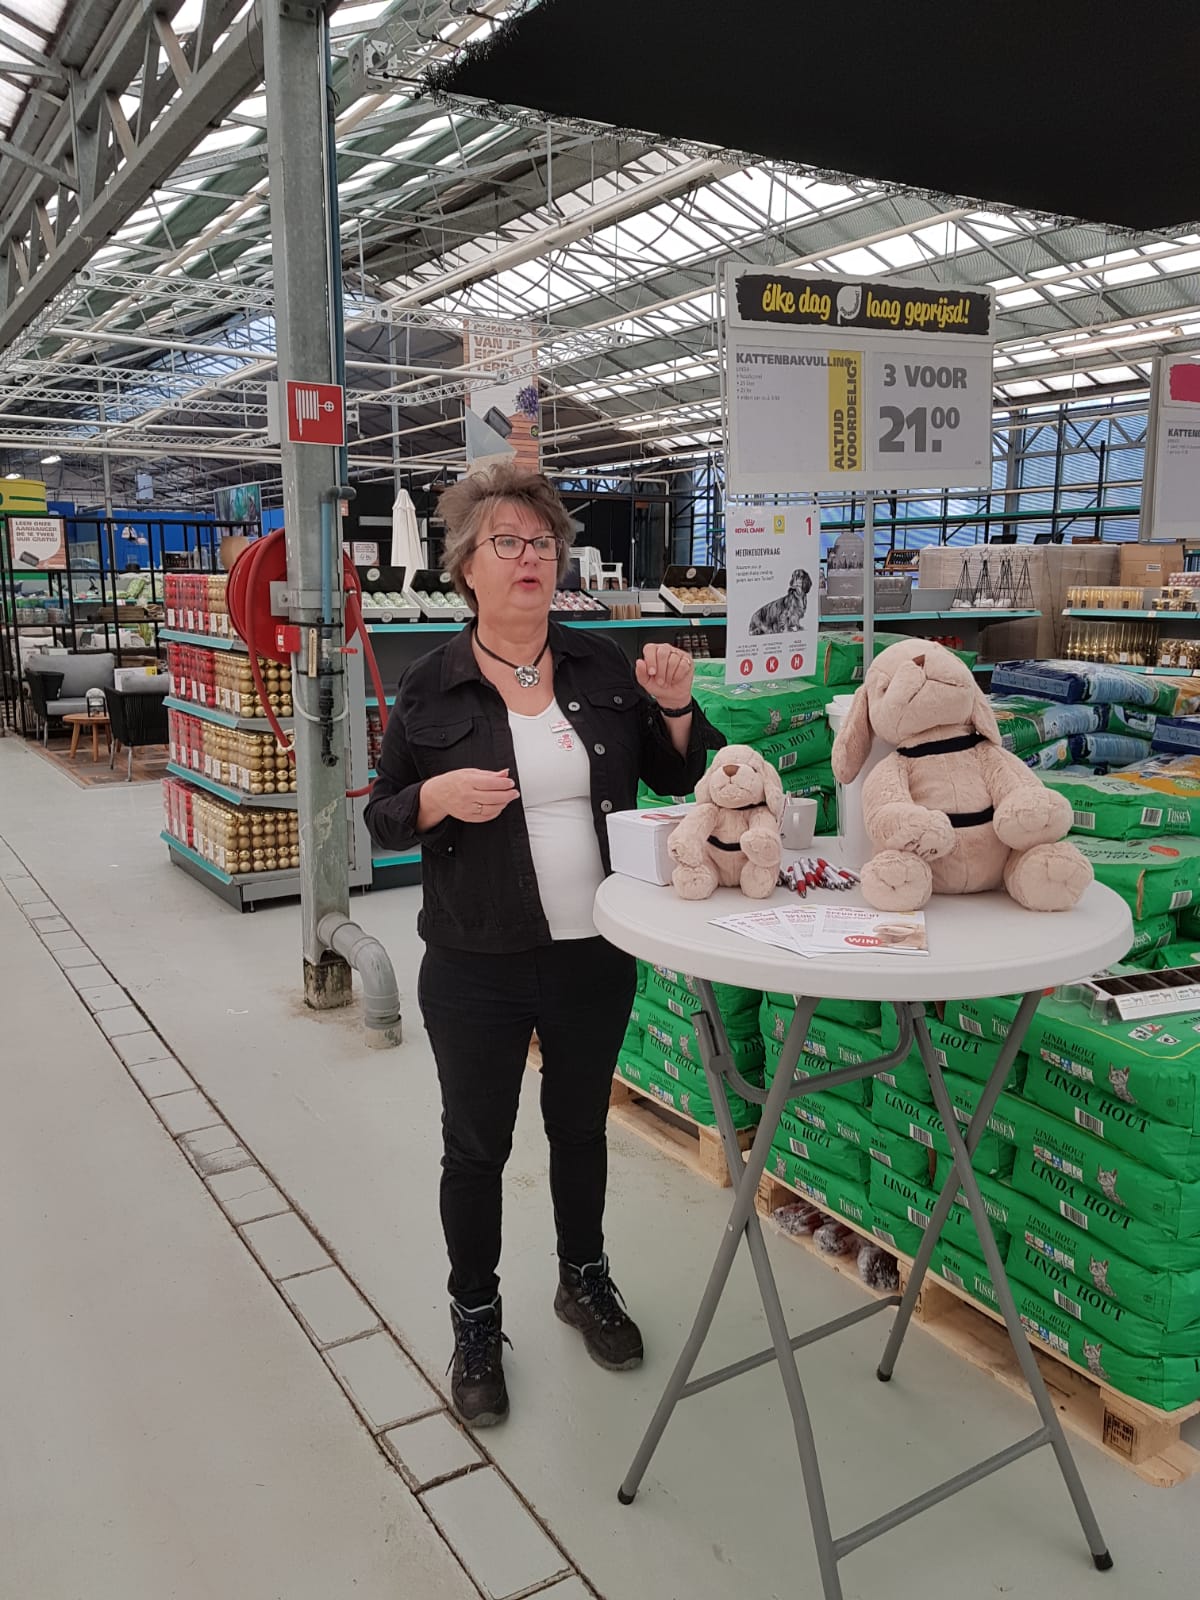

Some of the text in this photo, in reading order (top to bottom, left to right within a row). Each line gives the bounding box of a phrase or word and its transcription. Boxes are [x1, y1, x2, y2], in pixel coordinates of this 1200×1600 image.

[762, 282, 796, 315] élke
[798, 286, 832, 322] dag
[866, 291, 900, 326] laag
[905, 297, 971, 328] geprijsd!
[474, 335, 502, 349] VAN
[883, 363, 968, 389] 3 VOOR
[833, 408, 845, 470] ALTIJD
[805, 516, 812, 536] 1
[743, 656, 801, 673] A K H
[789, 730, 816, 747] HOUT
[847, 936, 879, 945] WIN!
[653, 974, 700, 1010] LINDA HOU
[940, 1033, 982, 1055] HOUT
[1042, 1031, 1097, 1059] LINDA HOUT
[885, 1092, 920, 1121] LINDA
[1045, 1068, 1151, 1134] LINDA HOUT
[802, 1127, 832, 1149] HOUT
[1034, 1128, 1086, 1160] LINDA HOUT
[883, 1174, 965, 1226] LINDA HUT
[1031, 1159, 1135, 1230] LINDA HOUT
[1027, 1214, 1079, 1249] LINDA HOUT
[1025, 1247, 1127, 1322] LINDA HOUT
[1022, 1297, 1073, 1332] LINDA HOUT
